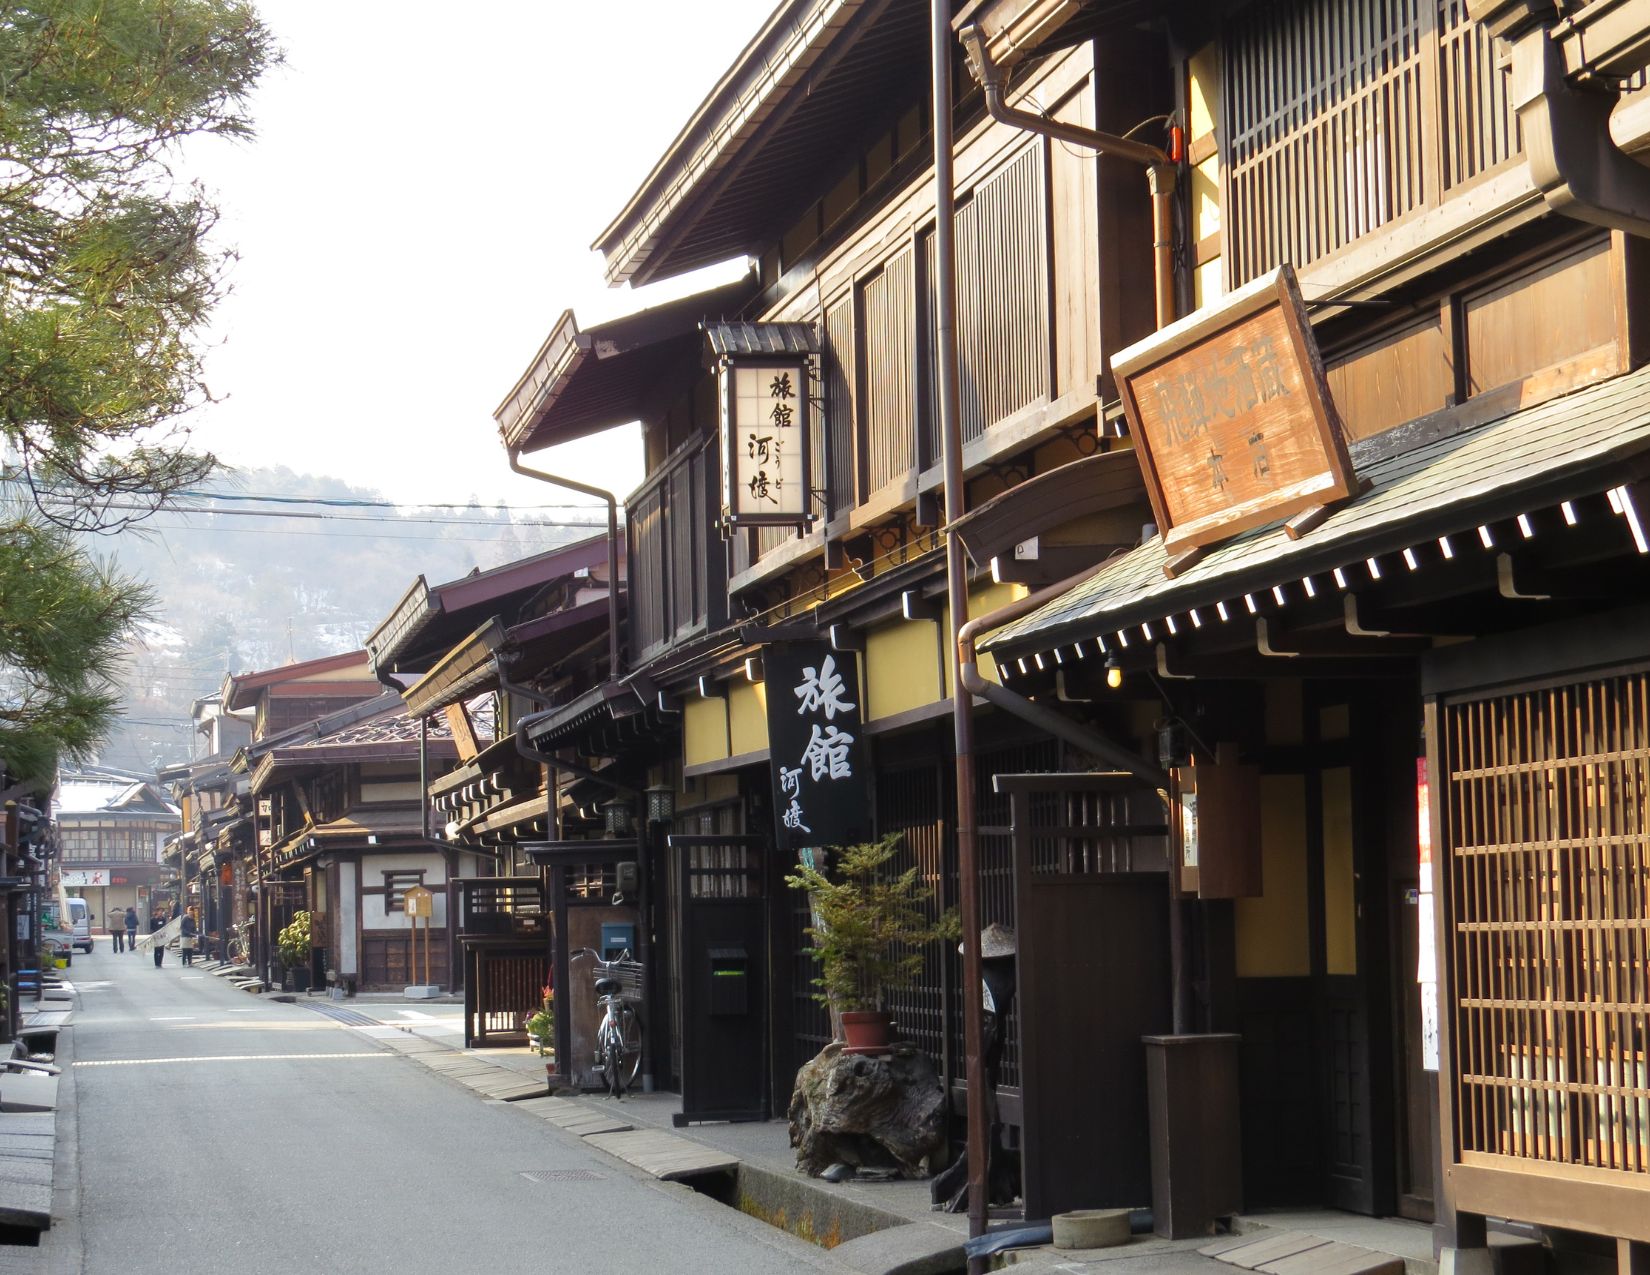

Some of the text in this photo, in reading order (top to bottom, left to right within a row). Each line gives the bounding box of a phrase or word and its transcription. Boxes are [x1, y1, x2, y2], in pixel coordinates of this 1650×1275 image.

[769, 372, 796, 428] 旅館
[774, 441, 784, 490] ごうど
[793, 654, 856, 782] 旅館
